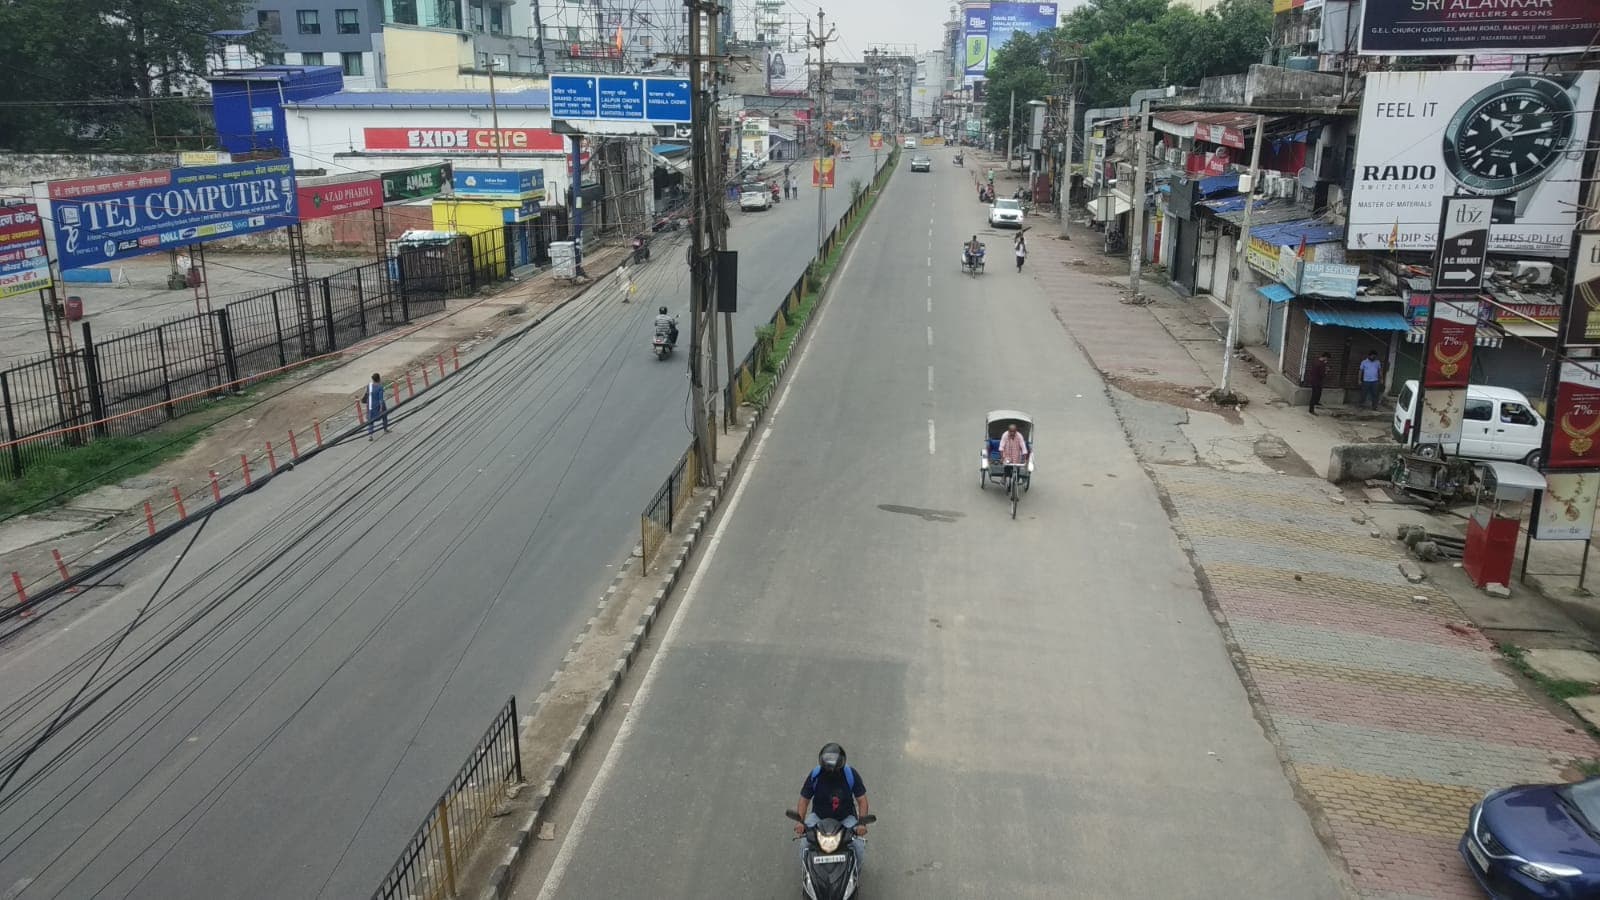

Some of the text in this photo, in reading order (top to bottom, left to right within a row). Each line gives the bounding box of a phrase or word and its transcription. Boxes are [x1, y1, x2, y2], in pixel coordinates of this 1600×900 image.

[1411, 0, 1553, 11] SRI ALANKAR
[1447, 10, 1508, 18] JEWELLERS
[1376, 102, 1439, 118] FEEL IT
[407, 129, 528, 148] EXIDE care
[1362, 165, 1436, 181] RADO
[406, 172, 433, 191] AMAZE
[324, 186, 374, 201] AZAD PHARMA
[82, 196, 137, 231] TEJ
[145, 179, 279, 221] COMPUTER
[1396, 200, 1433, 208] MATERIALS
[1456, 204, 1482, 223] tbz
[160, 231, 179, 243] DELL
[1377, 233, 1421, 243] KDIP
[1457, 238, 1473, 246] NOW
[1456, 256, 1482, 265] MARKET
[1305, 263, 1325, 273] STAR
